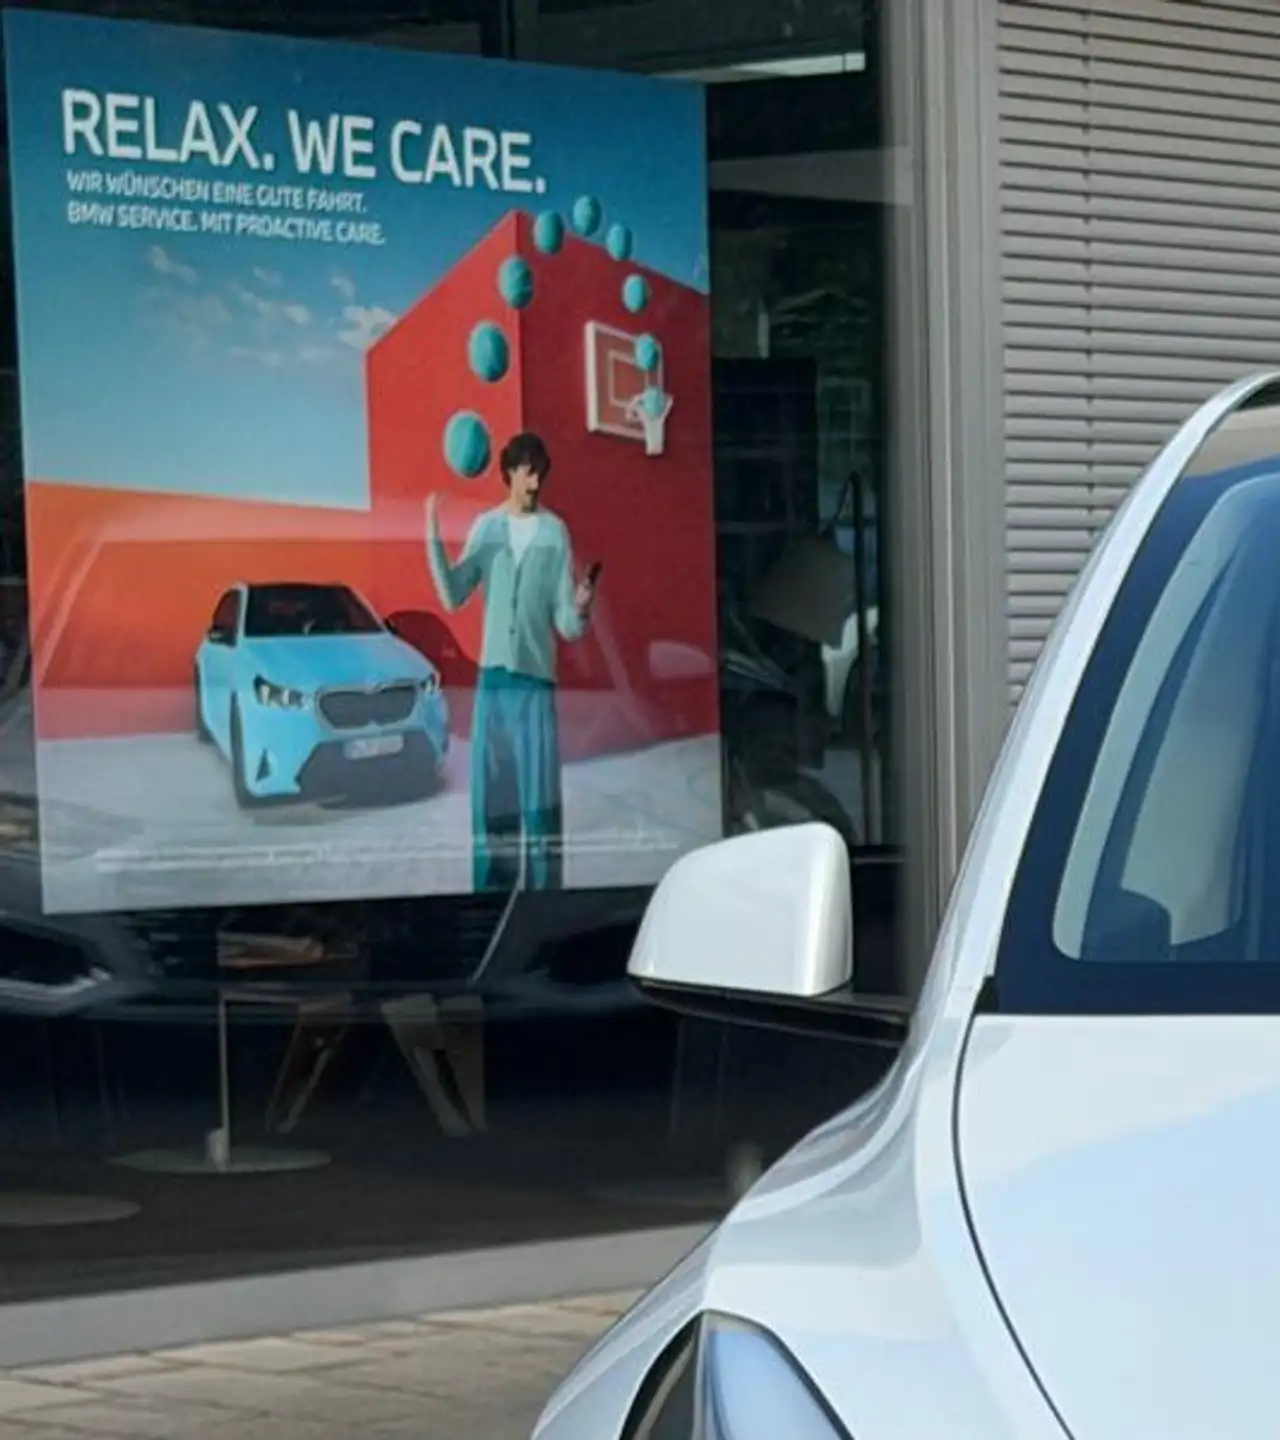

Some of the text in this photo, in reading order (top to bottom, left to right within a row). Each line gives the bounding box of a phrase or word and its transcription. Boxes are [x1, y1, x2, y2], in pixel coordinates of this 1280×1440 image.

[62, 88, 546, 194] RELAX. WE CARE.
[66, 170, 368, 213] WIR WÜNSCHEN EINE GUTE FAHRT.
[67, 200, 386, 245] BMW SERVICE. MIT PROACTIVE CARE.
